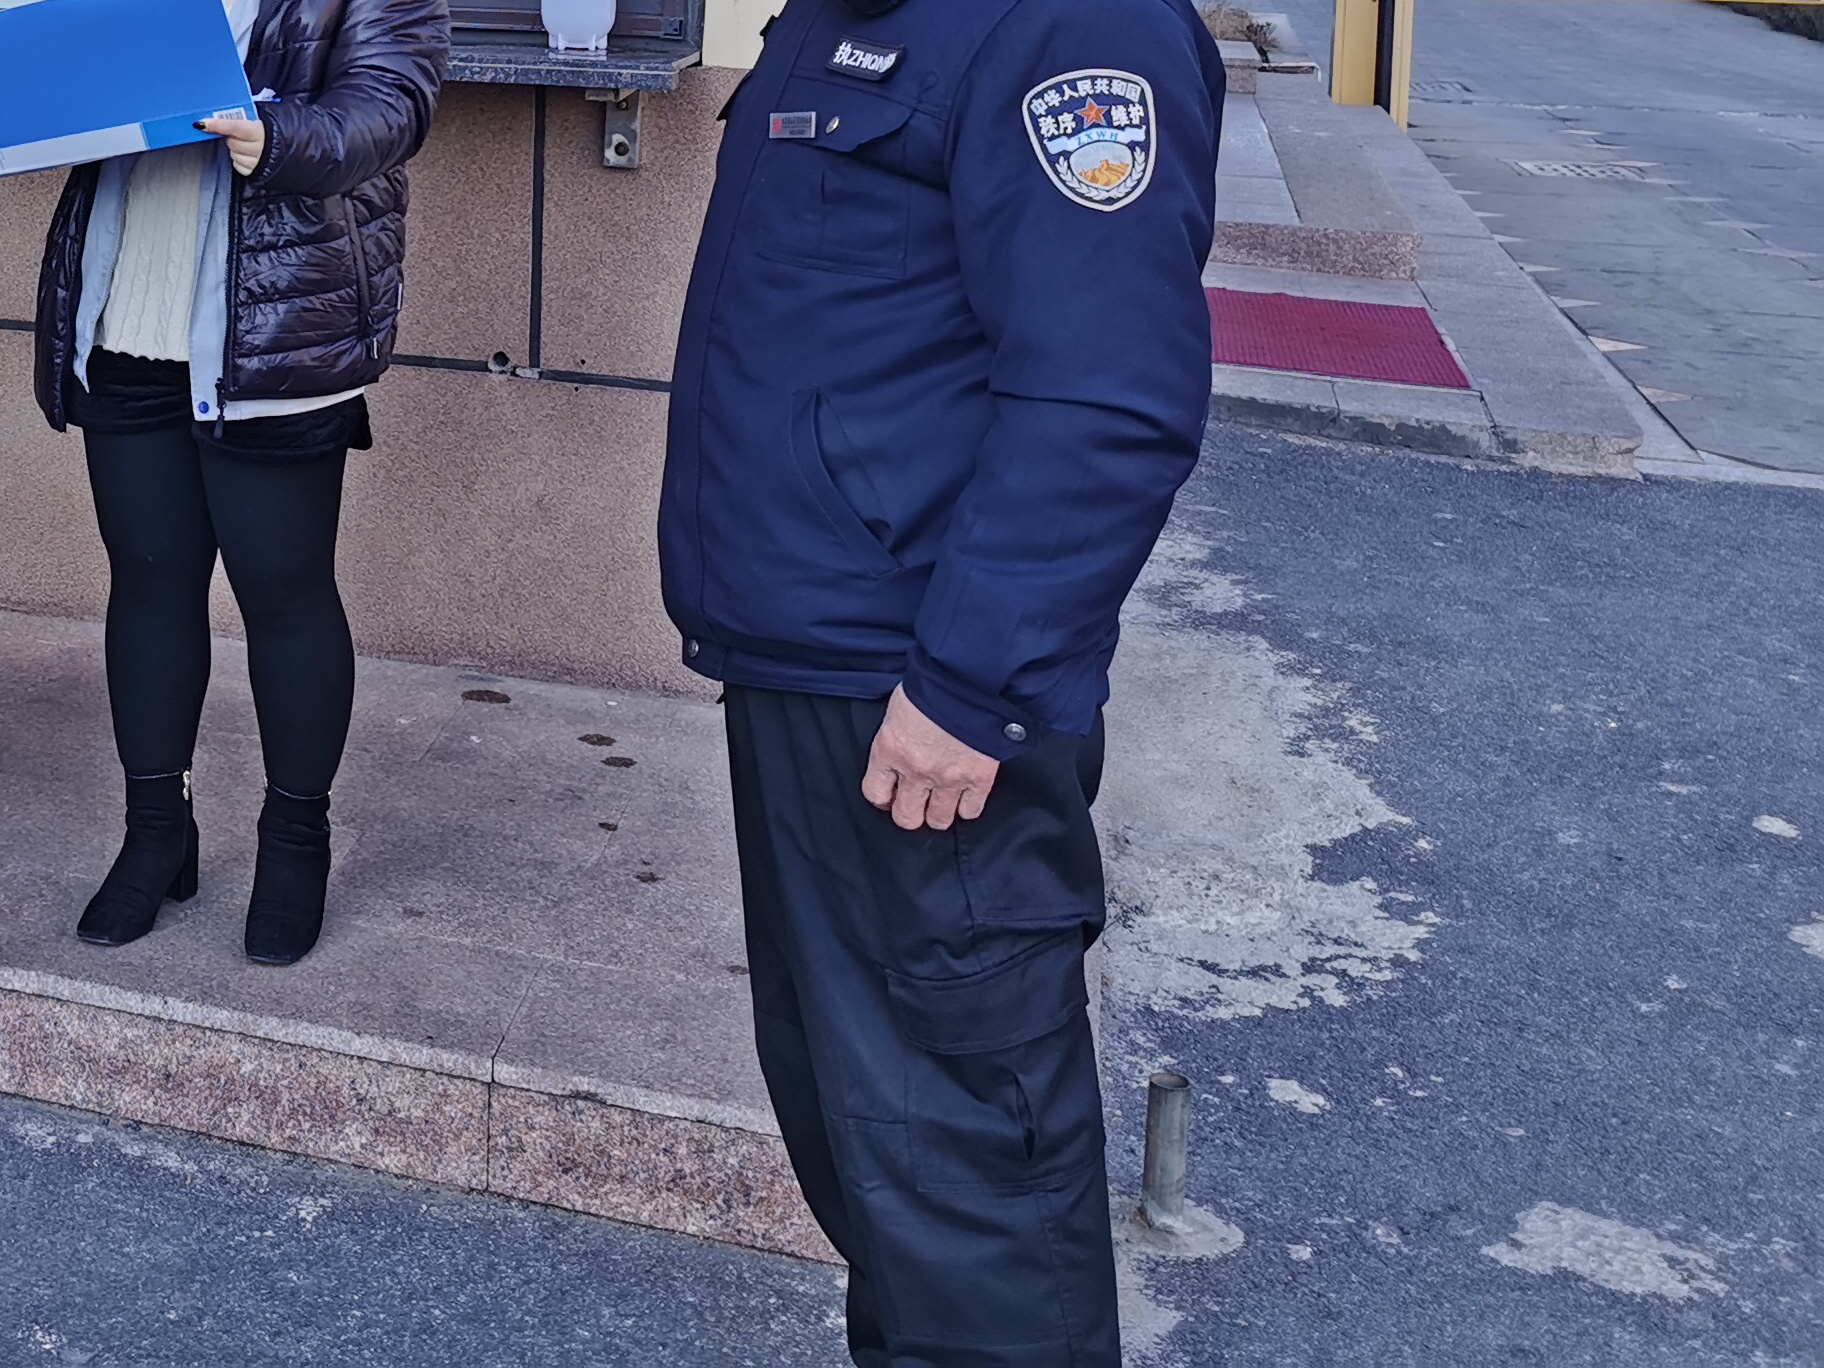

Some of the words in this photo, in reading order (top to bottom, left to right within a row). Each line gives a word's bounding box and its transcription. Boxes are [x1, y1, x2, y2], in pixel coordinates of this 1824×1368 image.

[1029, 77, 1142, 116] 中华人民共和国
[1037, 112, 1076, 138] 秩序
[1110, 102, 1145, 127] 维护
